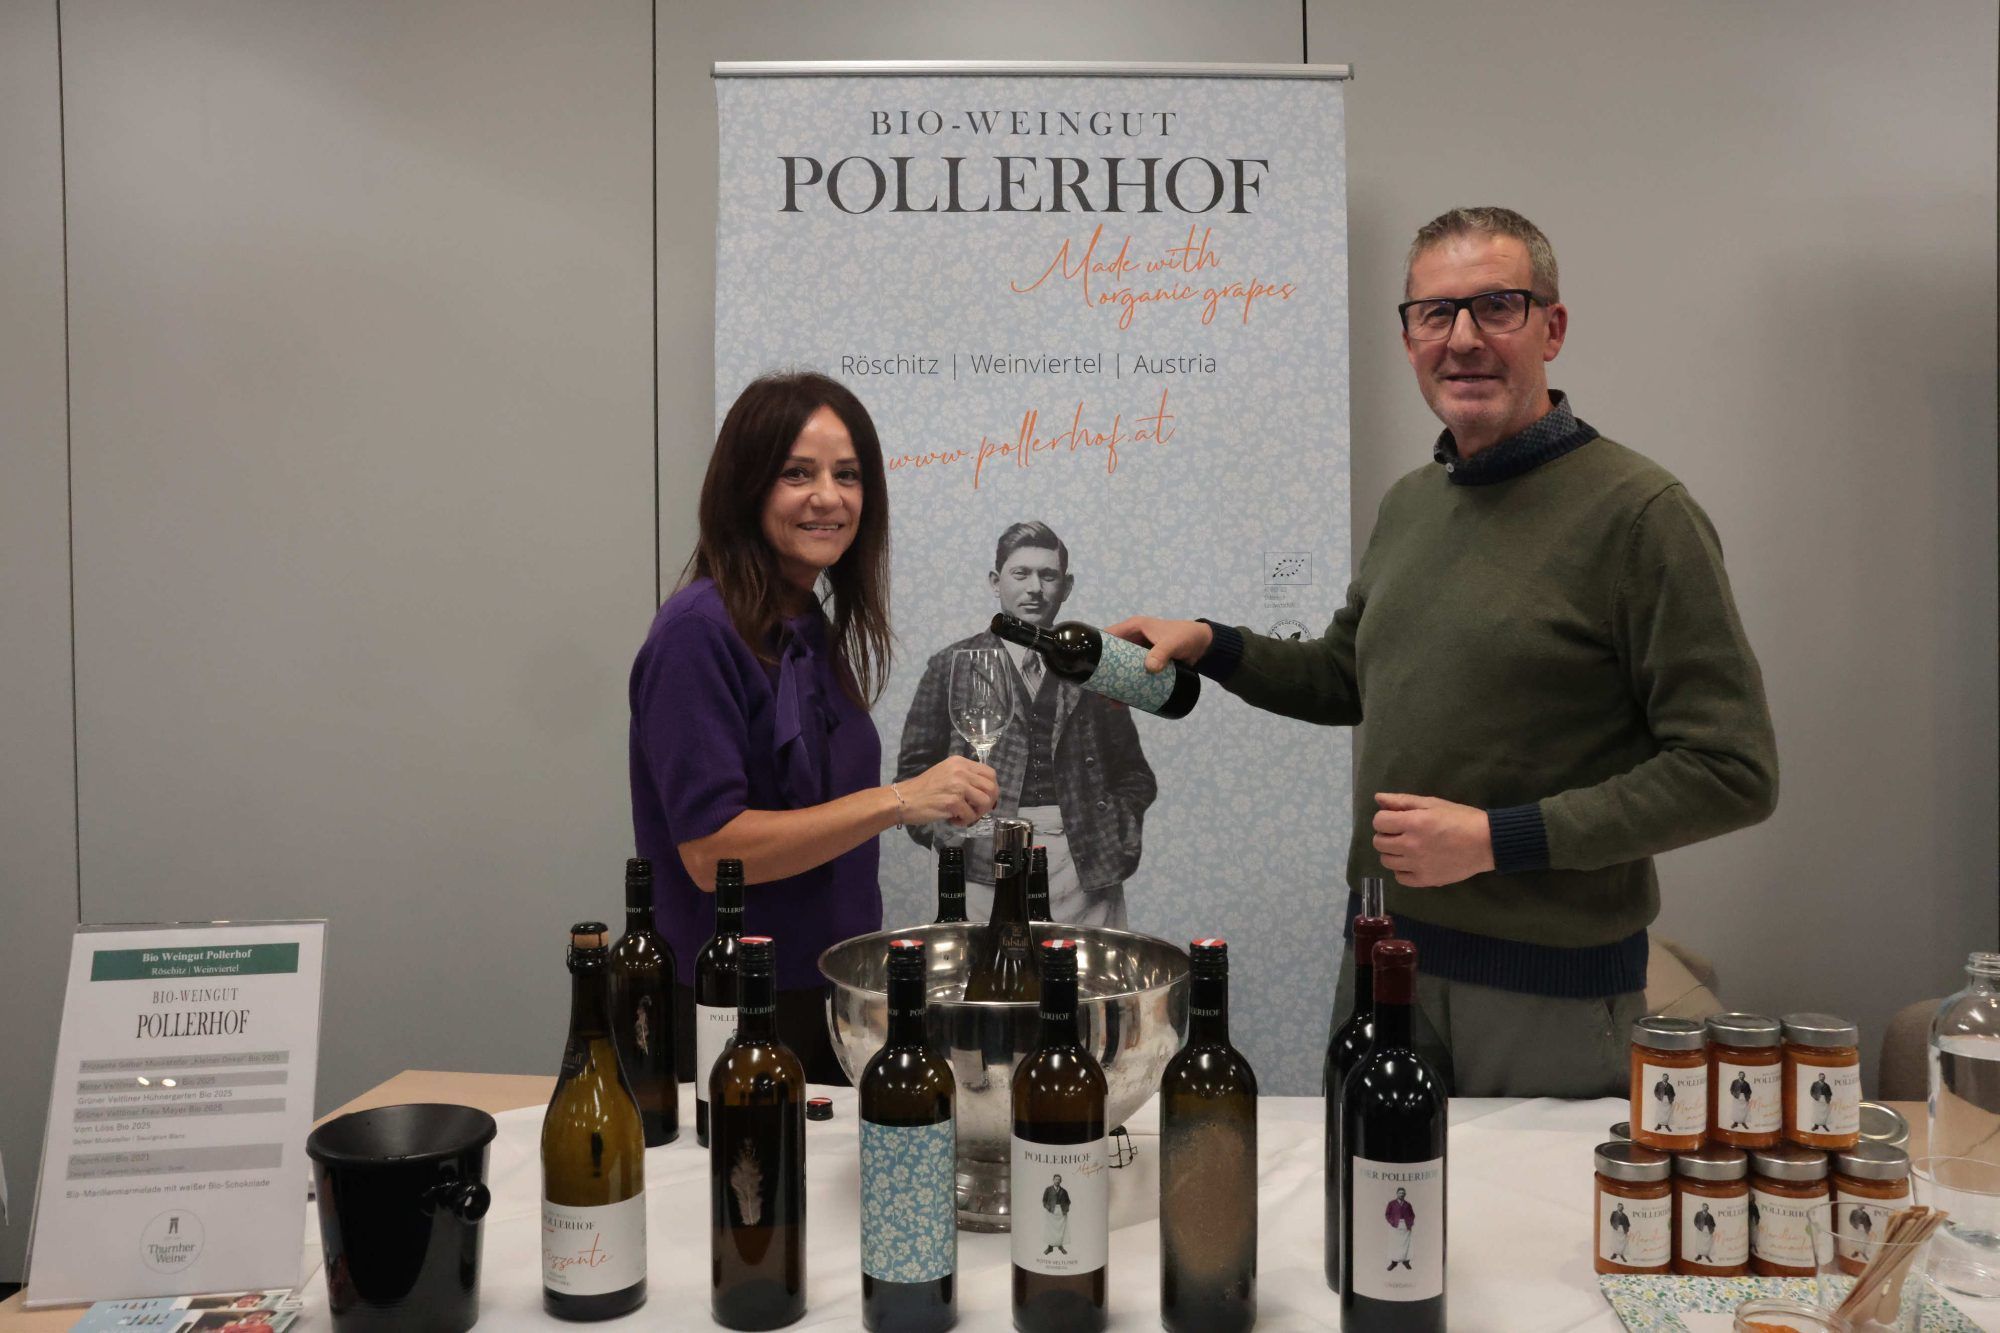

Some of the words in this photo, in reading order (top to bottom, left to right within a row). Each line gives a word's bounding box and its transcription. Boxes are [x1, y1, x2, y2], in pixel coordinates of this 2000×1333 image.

[871, 110, 1178, 137] BIO-WEINGUT
[777, 156, 1271, 215] POLLERHOF
[1011, 223, 1140, 308] Made
[1147, 224, 1221, 274] with
[1098, 282, 1199, 331] organic
[1202, 279, 1297, 325] grapes
[841, 353, 940, 377] Röschitz
[970, 352, 1103, 376] Weinviertel
[1134, 353, 1218, 376] Austria
[888, 388, 1177, 490] www.pollerhof.at
[142, 952, 159, 963] Bio
[162, 951, 204, 963] Weingut
[206, 948, 253, 960] Pollerhof
[151, 966, 186, 976] Röschitz
[193, 963, 240, 974] Weinviertel
[152, 987, 240, 1005] BIO-WEINGUT
[136, 1009, 250, 1039] POLLERHOF
[709, 1014, 737, 1022] POLLE
[199, 1090, 212, 1099] Bio
[214, 1089, 233, 1098] 2025
[117, 1122, 130, 1131] Bio
[1024, 1150, 1091, 1165] POLLERHOF
[155, 1254, 187, 1264] Weine
